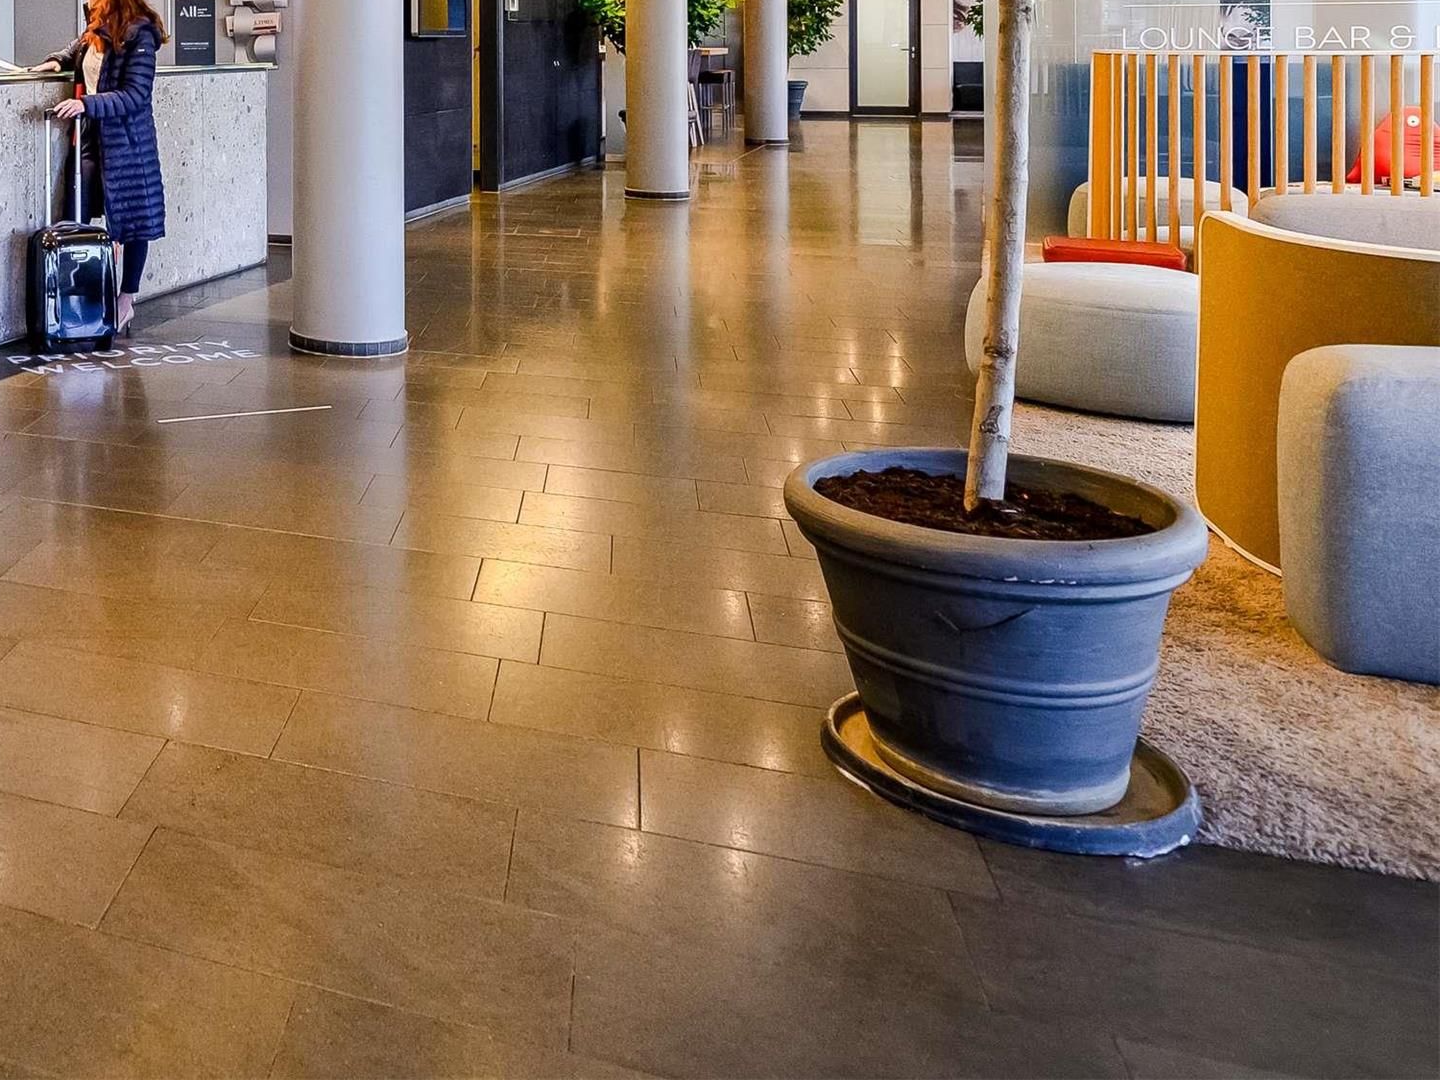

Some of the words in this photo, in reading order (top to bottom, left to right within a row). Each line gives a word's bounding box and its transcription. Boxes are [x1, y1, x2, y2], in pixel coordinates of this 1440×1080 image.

[180, 5, 197, 17] All
[1122, 26, 1275, 50] LOUNGE
[1295, 26, 1371, 49] BAR
[1390, 25, 1417, 49] &
[6, 340, 230, 365] PRIORITY
[20, 349, 262, 375] WELCOME
